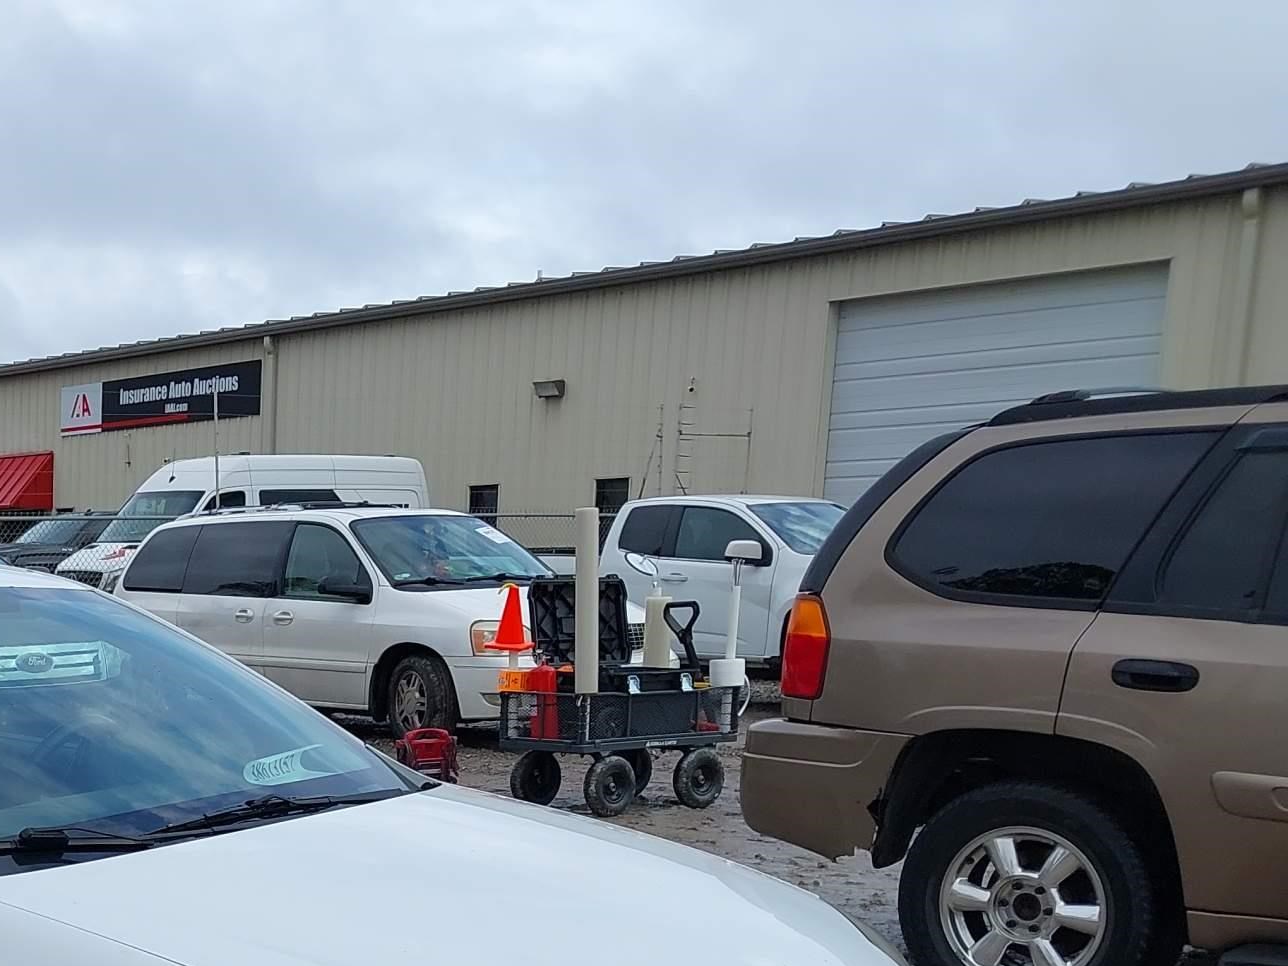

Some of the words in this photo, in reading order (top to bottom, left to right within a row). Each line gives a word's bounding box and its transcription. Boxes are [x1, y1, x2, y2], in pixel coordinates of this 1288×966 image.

[120, 385, 168, 405] Insurance
[168, 381, 192, 399] Auto
[192, 376, 239, 396] Auctions
